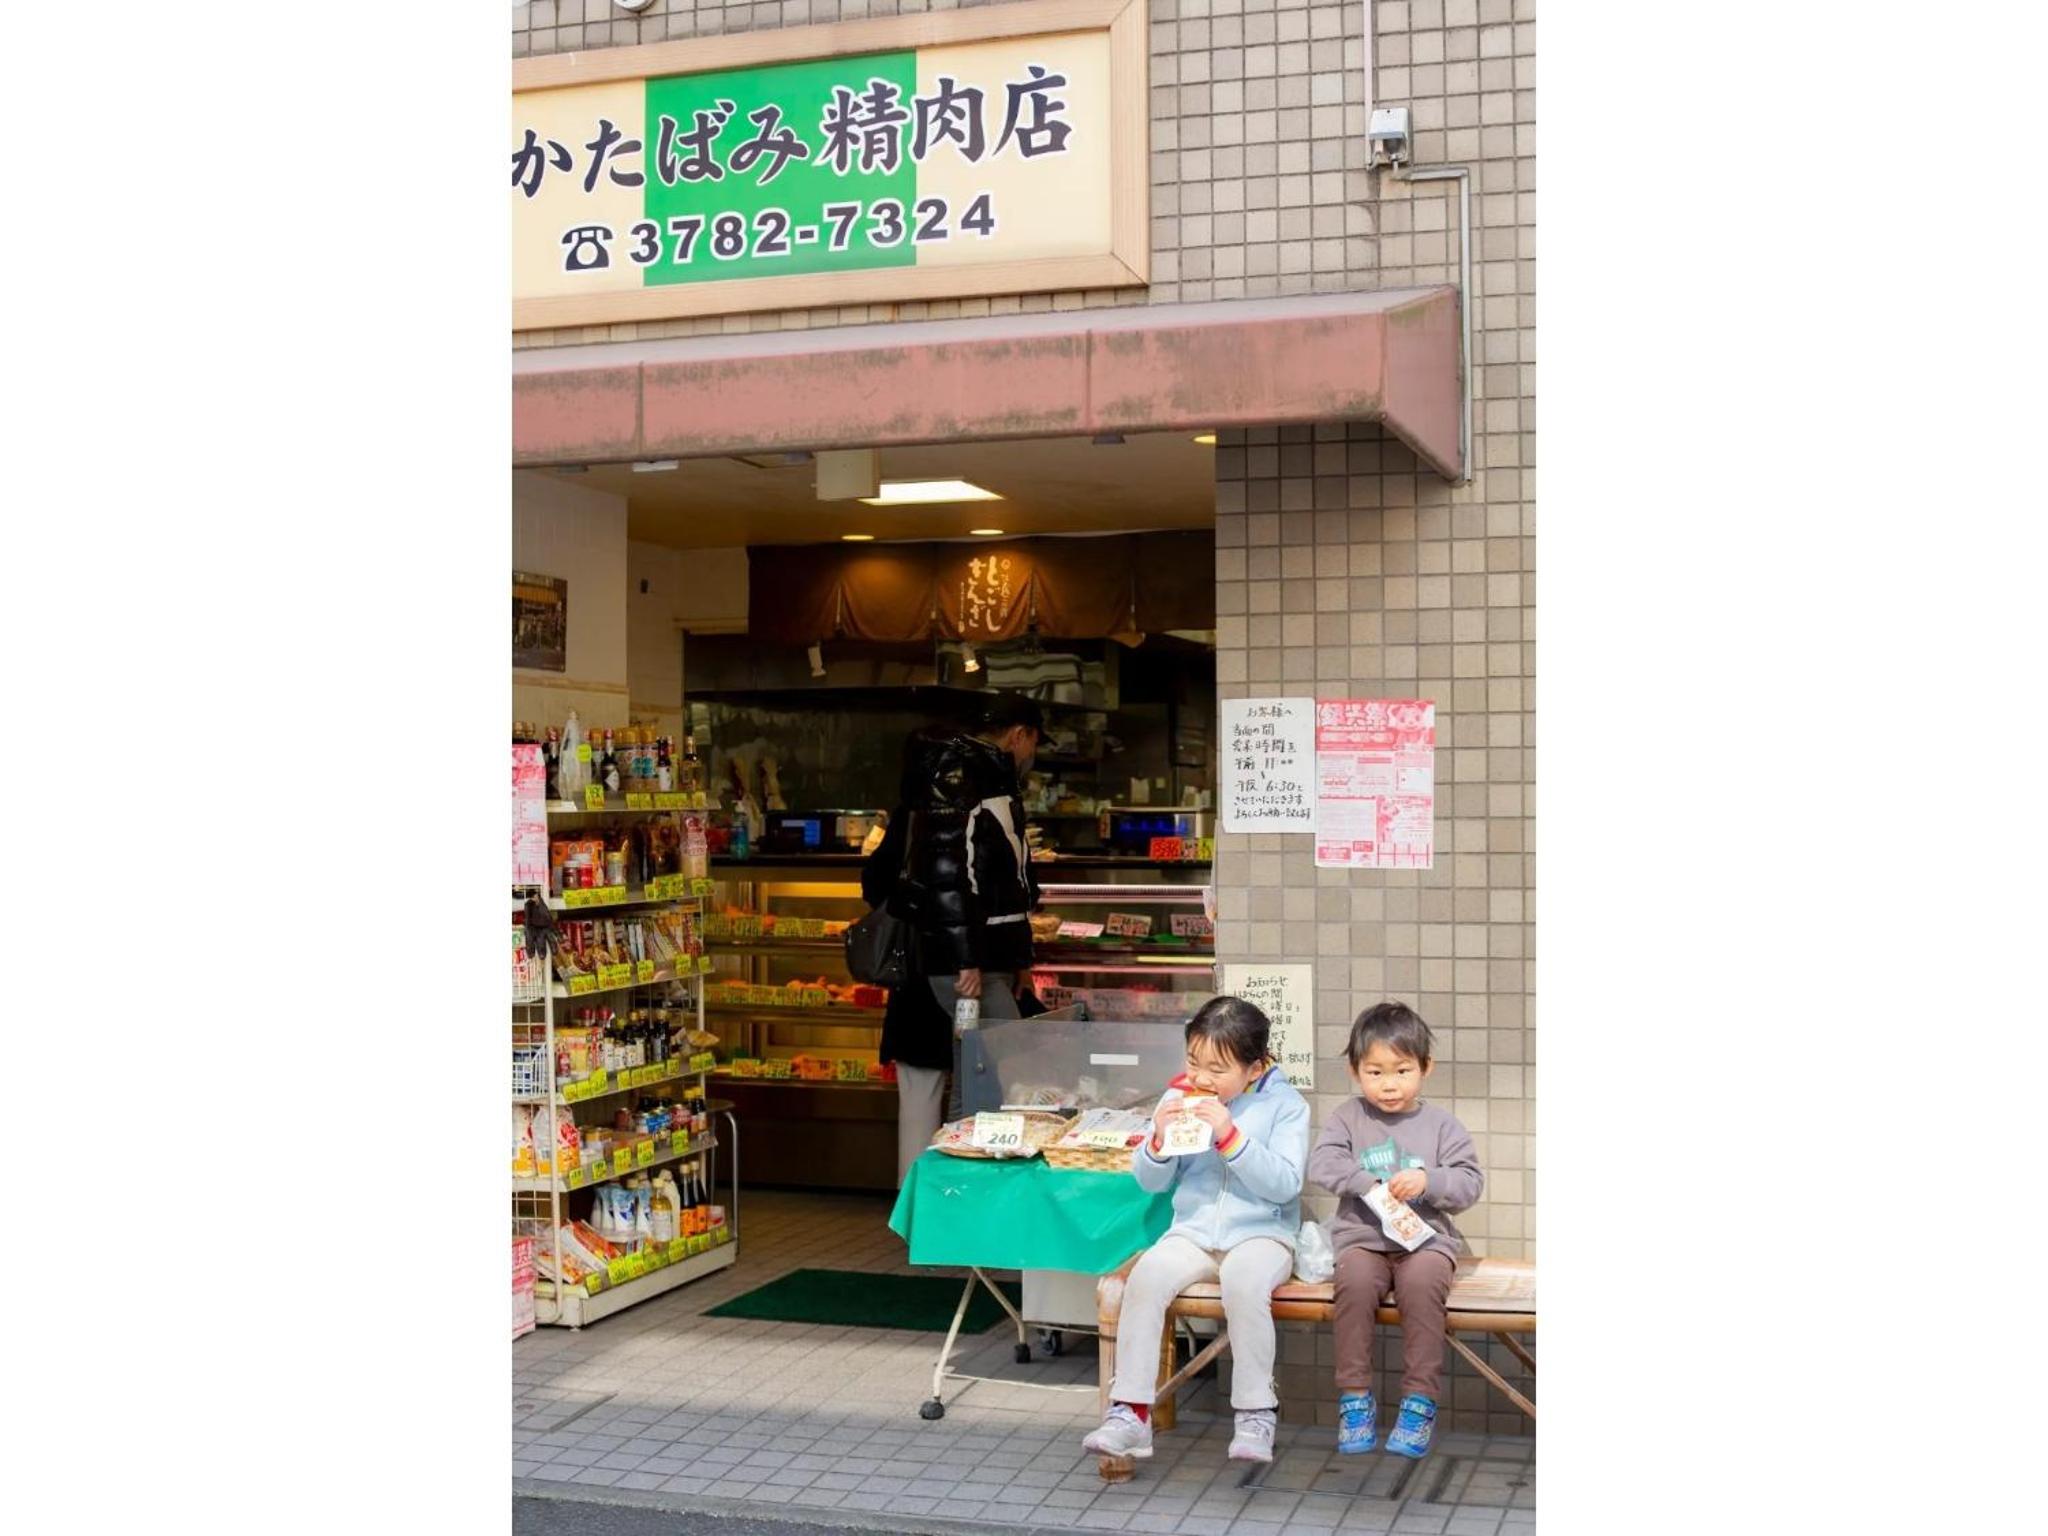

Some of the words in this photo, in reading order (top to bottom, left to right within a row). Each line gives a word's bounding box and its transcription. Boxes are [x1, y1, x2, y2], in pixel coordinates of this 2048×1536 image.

[512, 65, 1073, 197] かたばみ精肉店
[629, 194, 995, 264] 3782-7324
[987, 1133, 1018, 1145] 240
